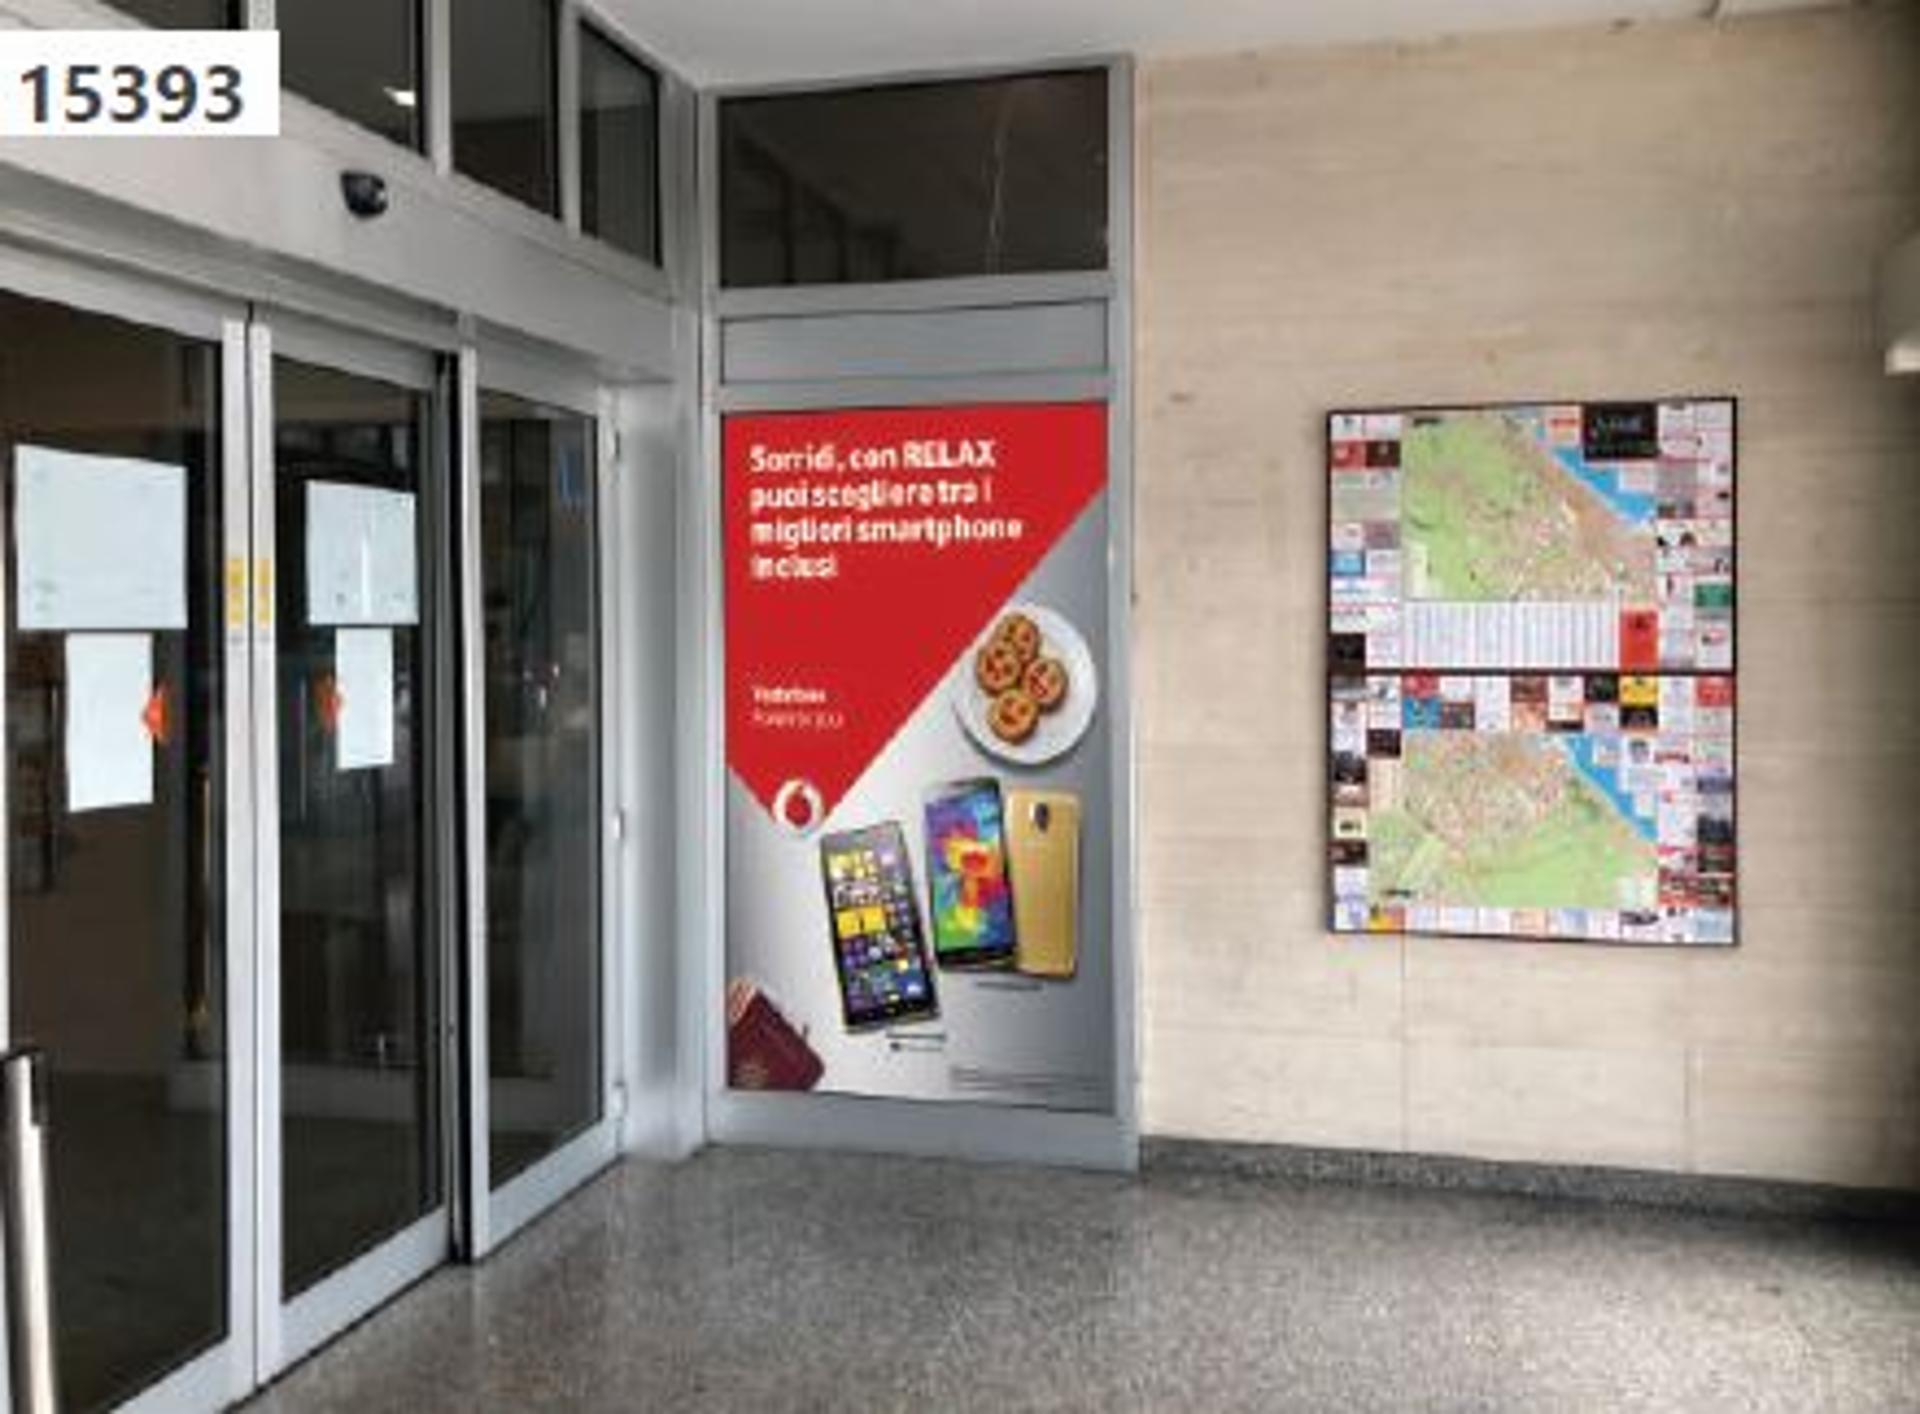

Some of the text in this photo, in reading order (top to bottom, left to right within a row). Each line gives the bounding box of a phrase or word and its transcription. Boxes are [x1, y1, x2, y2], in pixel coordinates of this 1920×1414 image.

[849, 447, 897, 469] con
[902, 440, 998, 468] RELAX
[750, 480, 807, 514] puoi
[937, 479, 979, 503] tra
[854, 513, 1024, 547] smartphone
